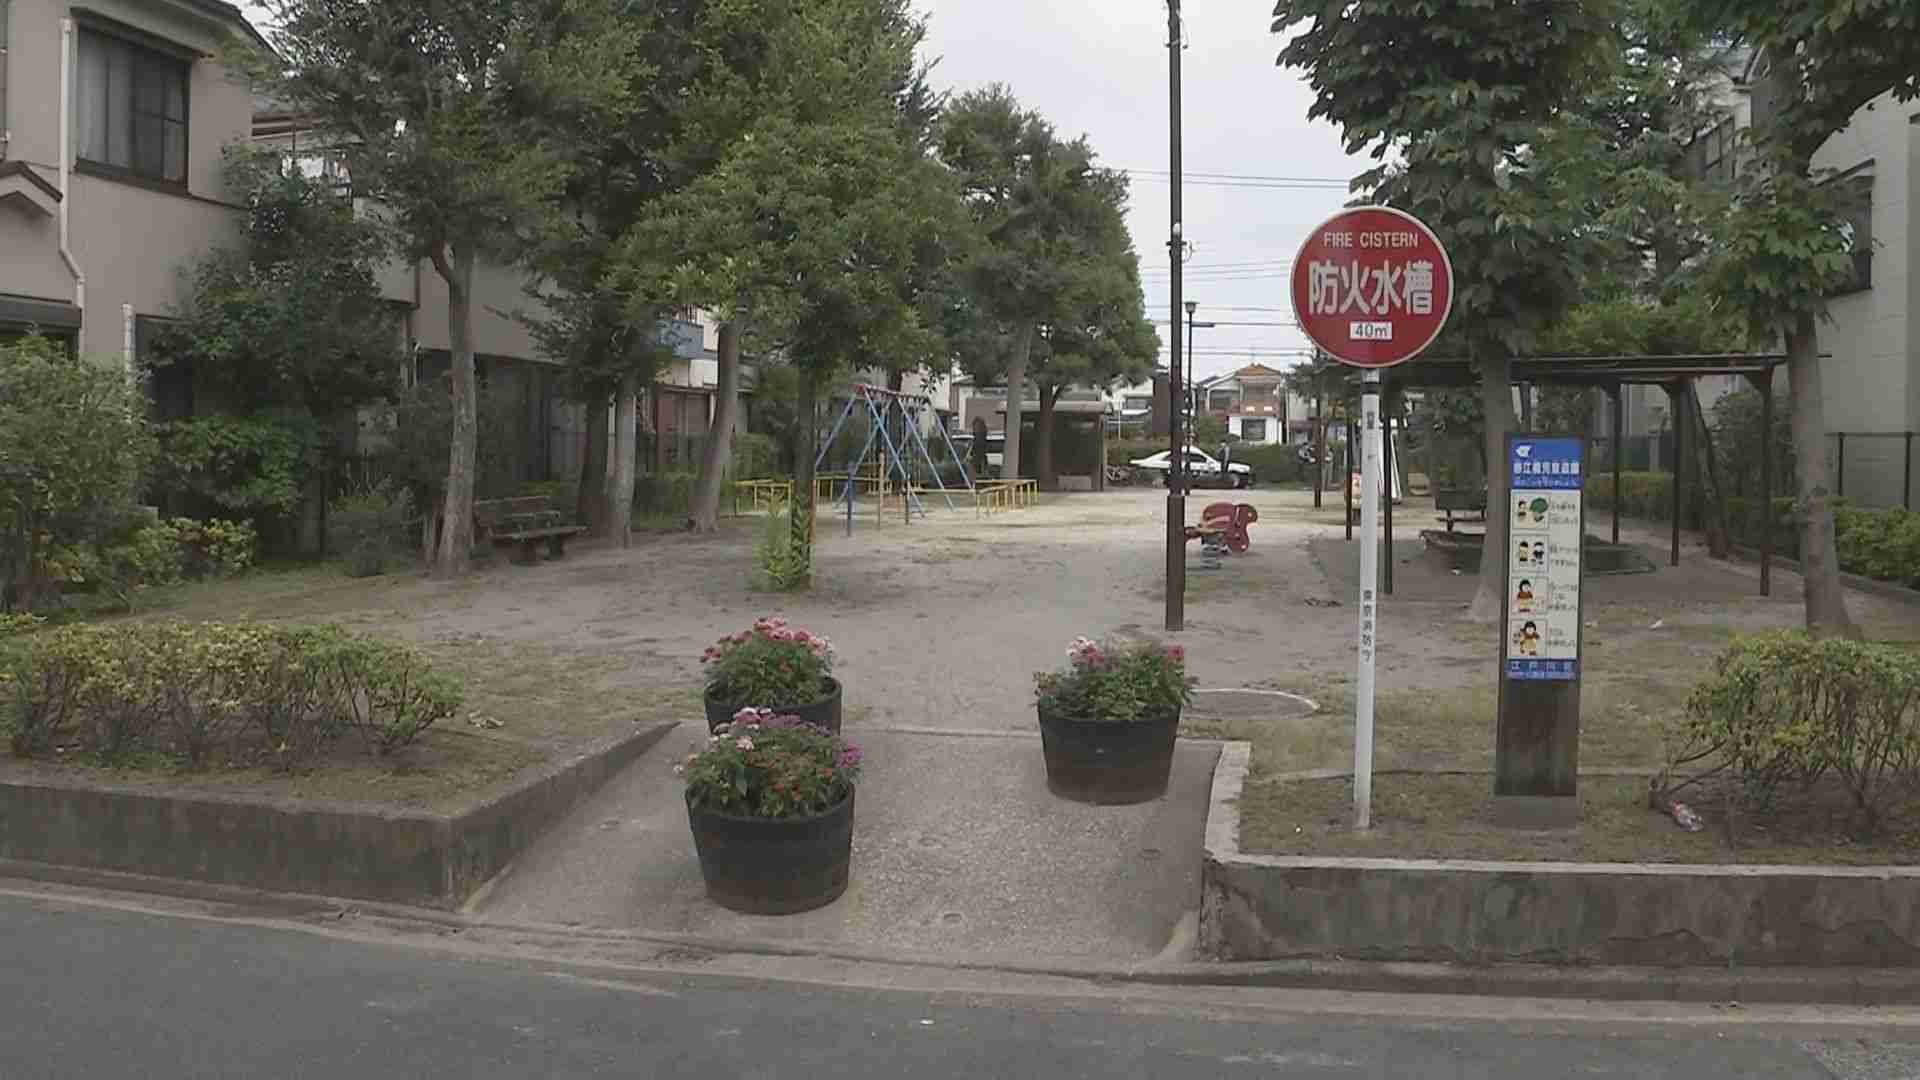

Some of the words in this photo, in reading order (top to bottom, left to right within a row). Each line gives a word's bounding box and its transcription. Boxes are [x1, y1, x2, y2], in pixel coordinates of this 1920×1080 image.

[1324, 232, 1353, 248] FIRE
[1360, 232, 1419, 248] CISTERN
[1308, 260, 1433, 315] 防火水槽
